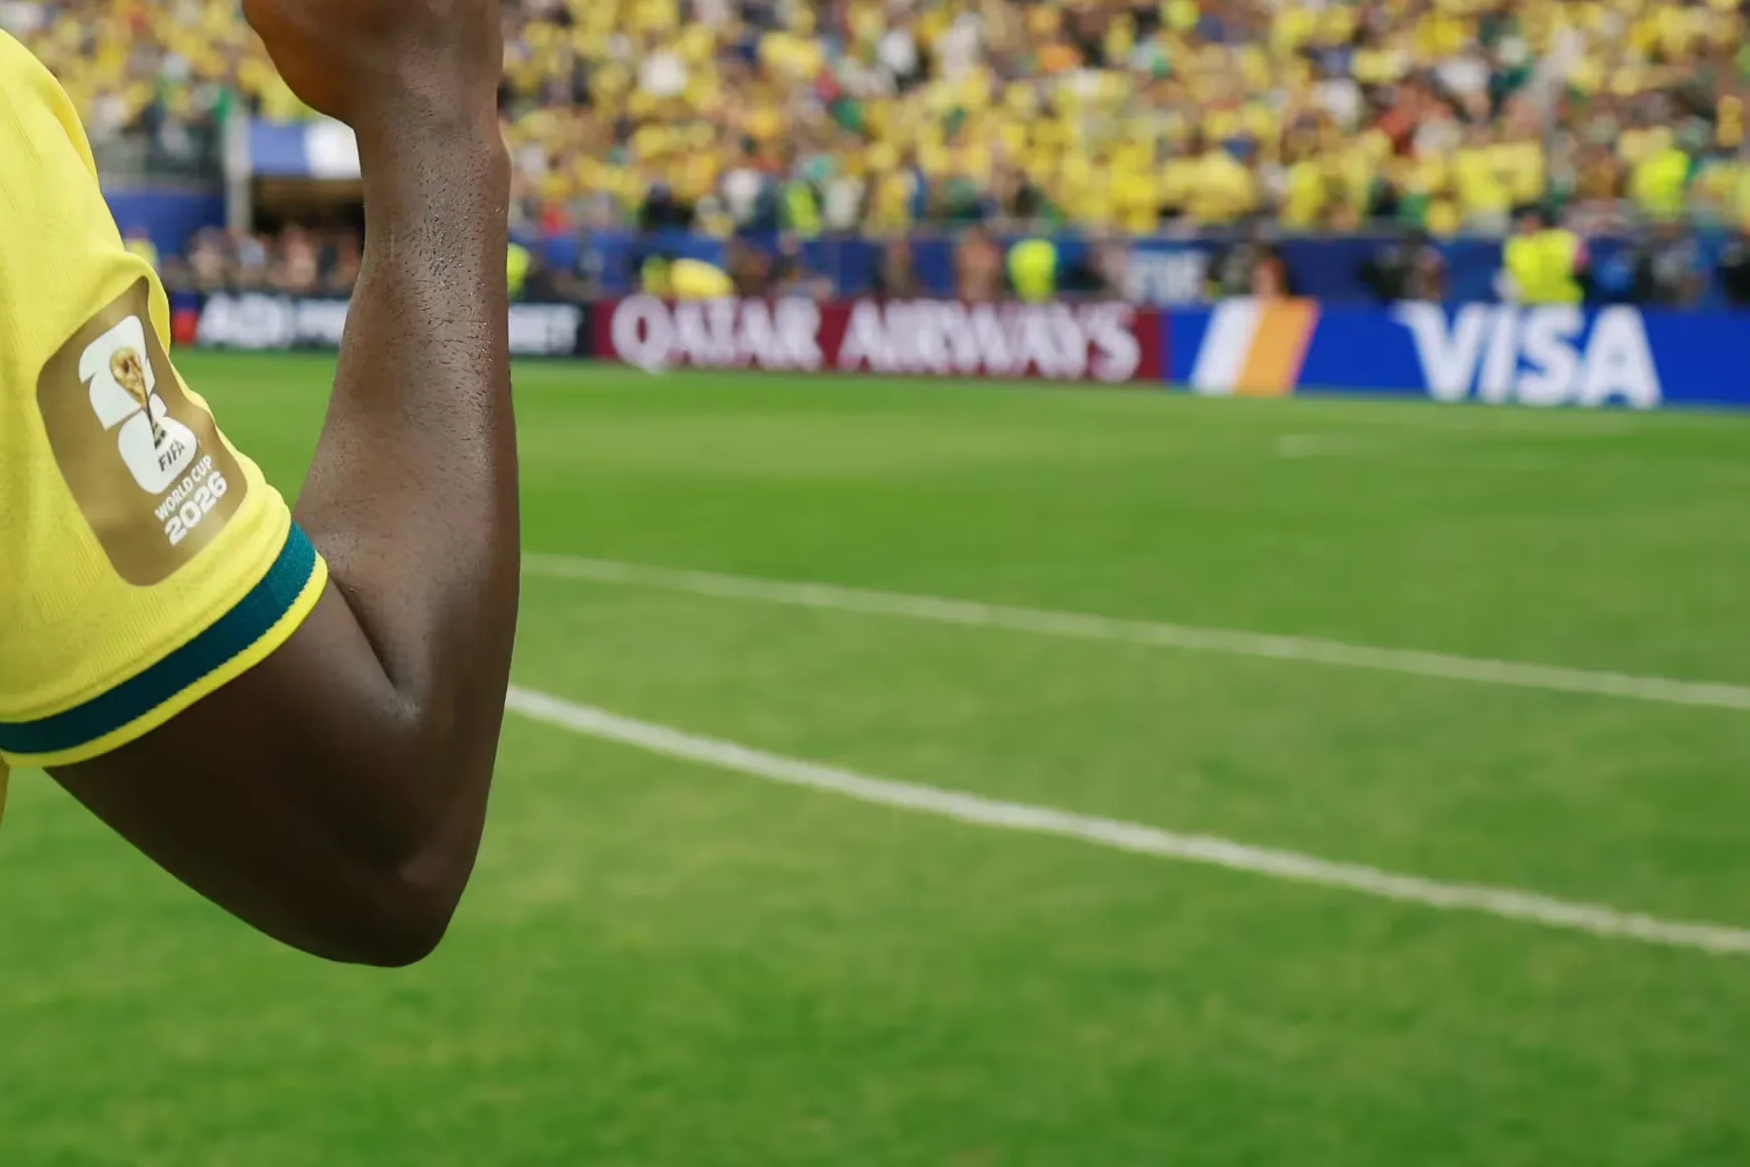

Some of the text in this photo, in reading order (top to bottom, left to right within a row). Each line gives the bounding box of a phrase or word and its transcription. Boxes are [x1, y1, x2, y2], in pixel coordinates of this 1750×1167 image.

[611, 293, 824, 374] QATAR
[838, 297, 1141, 384] AIRWAYS
[1388, 298, 1663, 410] VISA
[154, 454, 211, 522] WORLD CUP
[158, 439, 185, 472] FIFA
[164, 471, 228, 546] 2026
